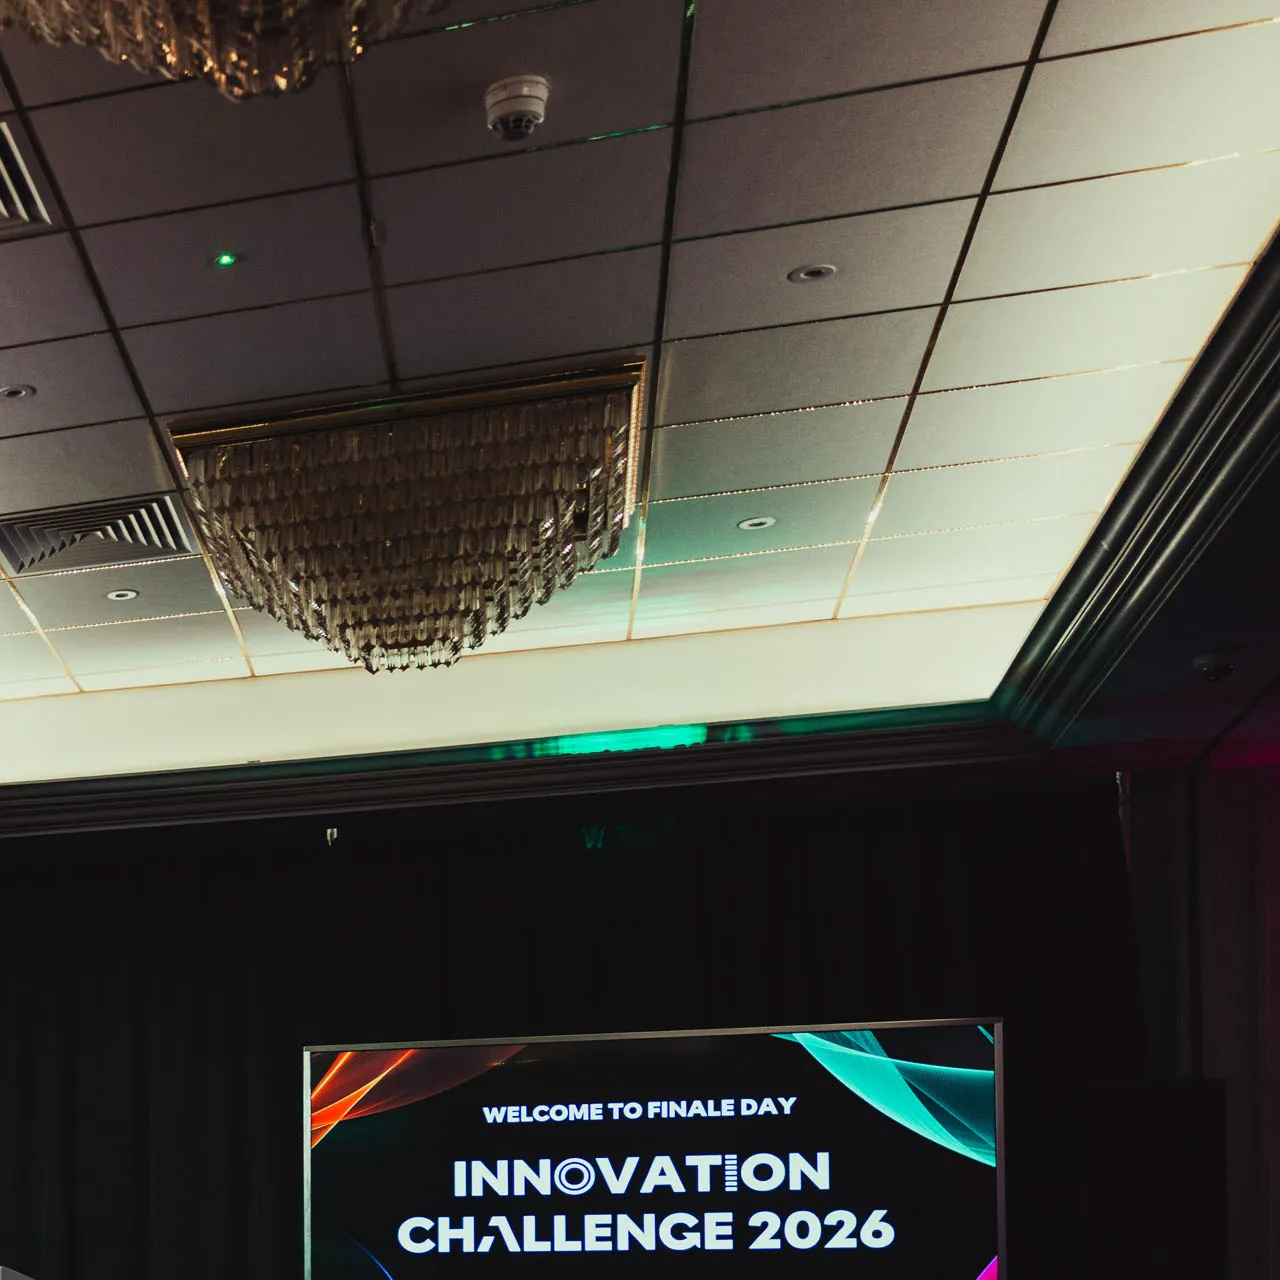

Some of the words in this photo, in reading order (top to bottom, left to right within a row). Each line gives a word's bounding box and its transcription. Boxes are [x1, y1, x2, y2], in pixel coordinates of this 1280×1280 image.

[483, 1103, 603, 1123] WELCOME
[608, 1102, 643, 1119] TO
[648, 1099, 735, 1118] FINALE
[741, 1097, 797, 1115] DAY
[454, 1152, 829, 1197] INNOVATION
[398, 1212, 733, 1253] CHALLENGE
[748, 1210, 895, 1249] 2026
